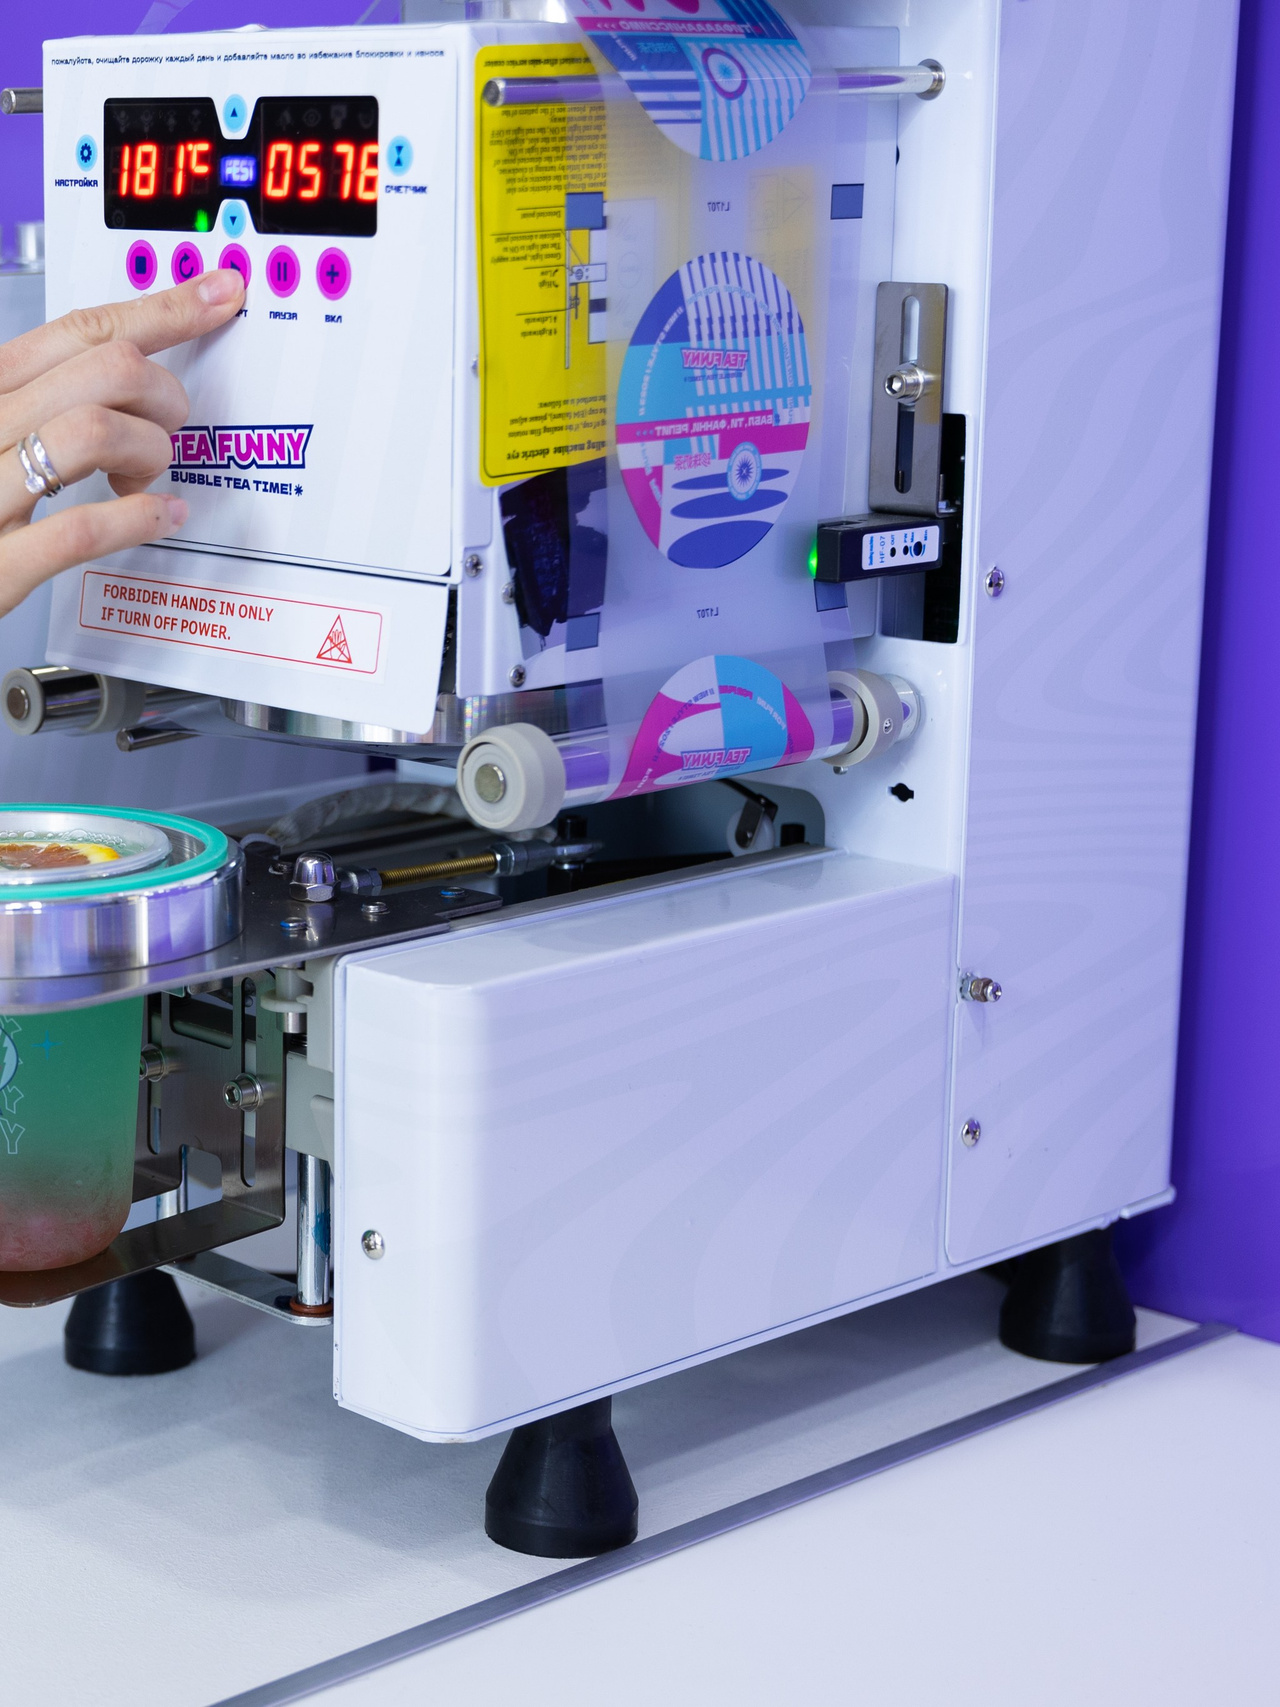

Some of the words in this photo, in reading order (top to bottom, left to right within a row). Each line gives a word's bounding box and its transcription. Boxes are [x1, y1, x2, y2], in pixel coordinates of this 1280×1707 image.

[96, 55, 130, 65] очищайте
[132, 55, 163, 65] дорожку
[165, 53, 195, 63] каждый
[196, 54, 215, 63] день
[223, 52, 268, 62] добавляйте
[355, 50, 404, 60] блокировки
[55, 177, 98, 187] НАСТРОЙКА
[385, 185, 428, 195] СЧЕТЧИК
[539, 280, 551, 289] High
[269, 311, 298, 321] ПАУЗА
[325, 314, 343, 324] ВКЛ
[216, 428, 311, 466] FUNNY
[553, 443, 585, 456] machine
[506, 449, 519, 461] eye
[521, 448, 549, 461] electric
[171, 471, 222, 488] BUBBLE
[224, 476, 251, 491] TEA
[253, 480, 292, 496] TIME!
[103, 583, 168, 607] FORBIDEN
[171, 594, 217, 614] HANDS
[219, 601, 236, 616] IN
[238, 604, 274, 623] ONLY
[101, 606, 115, 622] IF
[117, 609, 151, 628] TURN
[153, 615, 178, 632] OFF
[180, 618, 232, 641] POWER.
